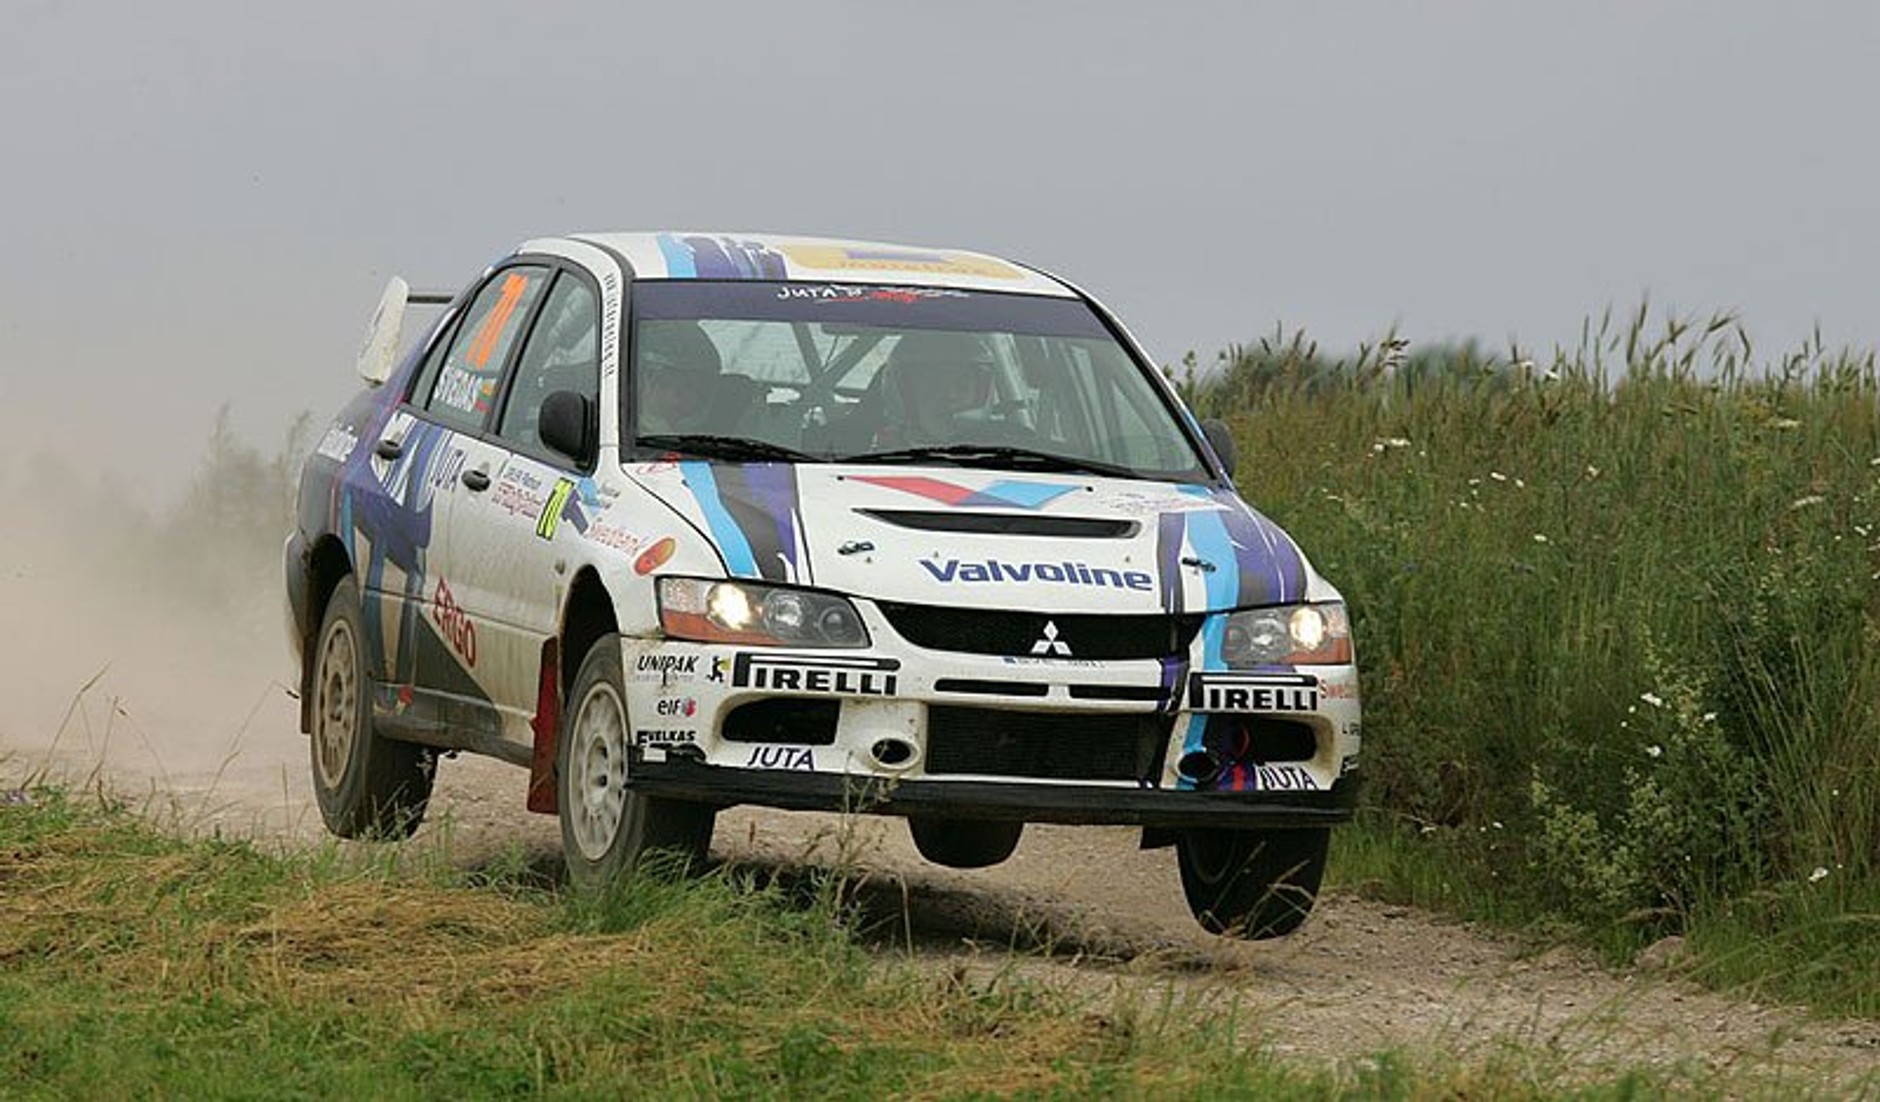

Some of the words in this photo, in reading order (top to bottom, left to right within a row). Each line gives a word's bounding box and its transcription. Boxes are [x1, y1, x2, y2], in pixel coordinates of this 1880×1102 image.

[465, 273, 529, 369] 70
[920, 559, 1154, 592] Valvoline
[433, 576, 475, 668] ERGO
[637, 655, 699, 686] UNIPAK
[732, 652, 900, 696] PIRELLI
[657, 699, 680, 715] elf
[1189, 672, 1318, 711] PIRELLI
[748, 747, 815, 770] JUTA
